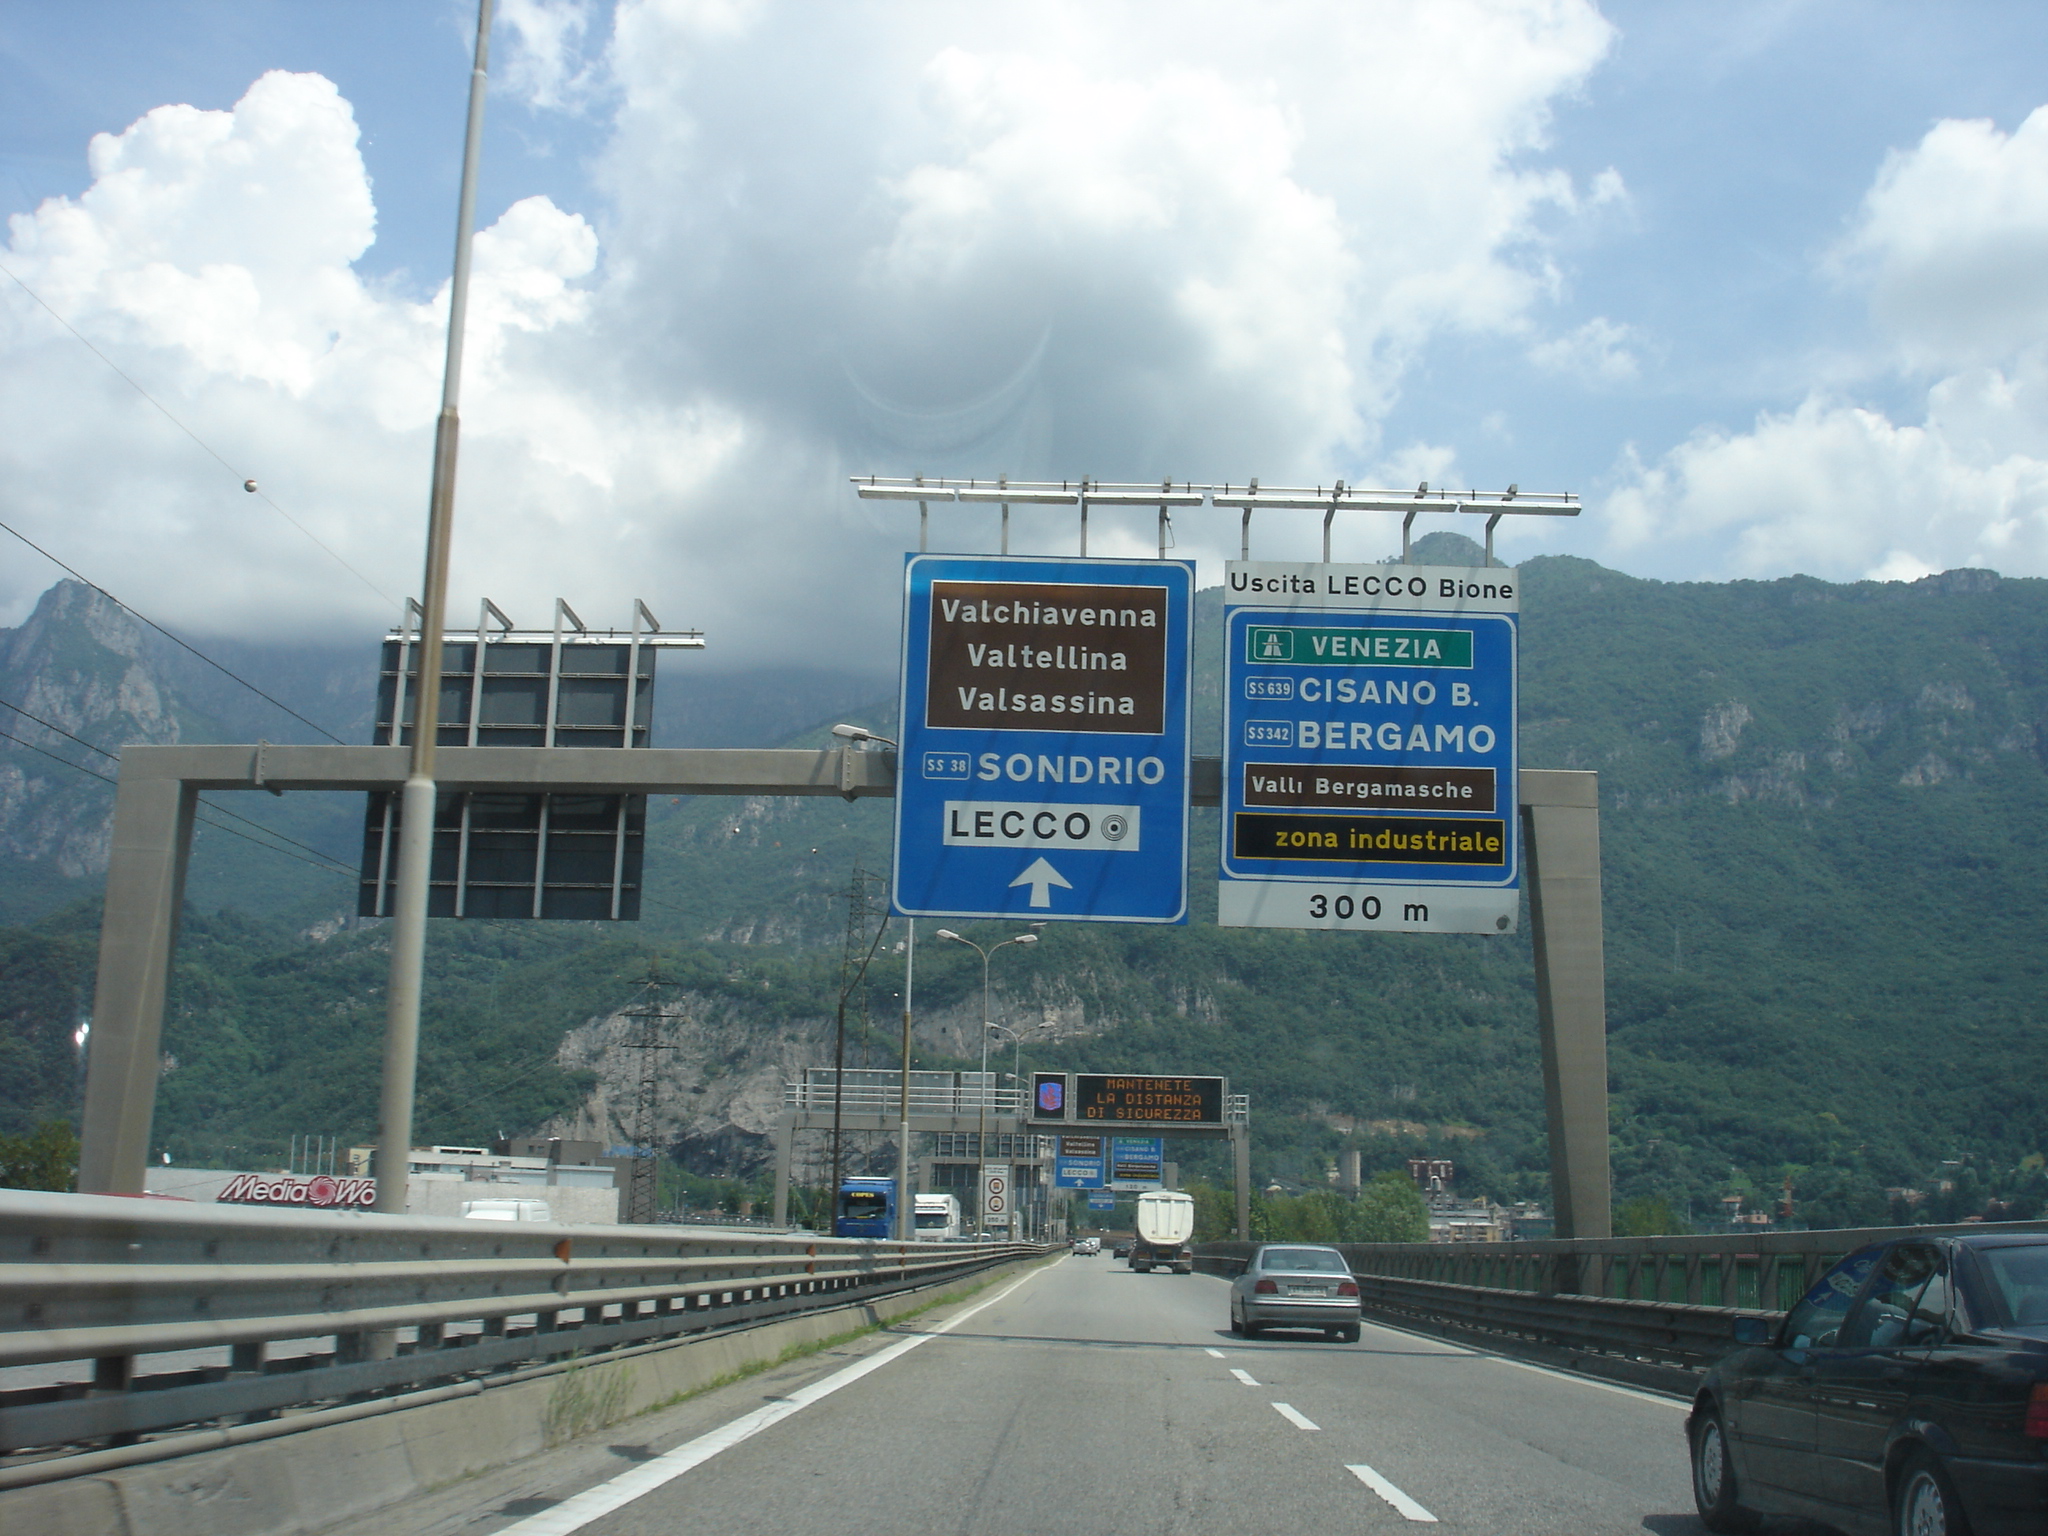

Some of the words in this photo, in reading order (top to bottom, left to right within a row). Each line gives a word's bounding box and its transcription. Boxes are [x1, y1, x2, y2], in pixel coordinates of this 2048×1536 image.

[1231, 573, 1315, 593] Uscita
[1328, 576, 1426, 596] LECCO
[1439, 579, 1513, 599] Bione
[942, 599, 1156, 627] Valchiavenna
[968, 644, 1126, 670] Valtellina
[1312, 636, 1441, 659] VENEZIA
[958, 687, 1134, 714] Valsassina
[1300, 677, 1436, 705] CISANO
[1452, 682, 1478, 707] B.
[1299, 721, 1495, 753] BERGAMO
[928, 759, 943, 771] SS
[951, 760, 966, 772] 38
[977, 753, 1164, 784] SONDRIO
[1252, 775, 1302, 794] Valli
[1316, 778, 1472, 799] Bergamasche
[951, 810, 1090, 840] LECCO
[1276, 830, 1337, 849] zona
[1350, 828, 1499, 852] industriale
[1310, 895, 1381, 919] 300
[1404, 902, 1428, 921] m
[1107, 1079, 1192, 1091] MANTENETE
[1097, 1093, 1115, 1103] LA
[1126, 1094, 1201, 1105] DISTANZA
[1088, 1107, 1104, 1118] DI
[1116, 1108, 1201, 1120] SICUREZZA
